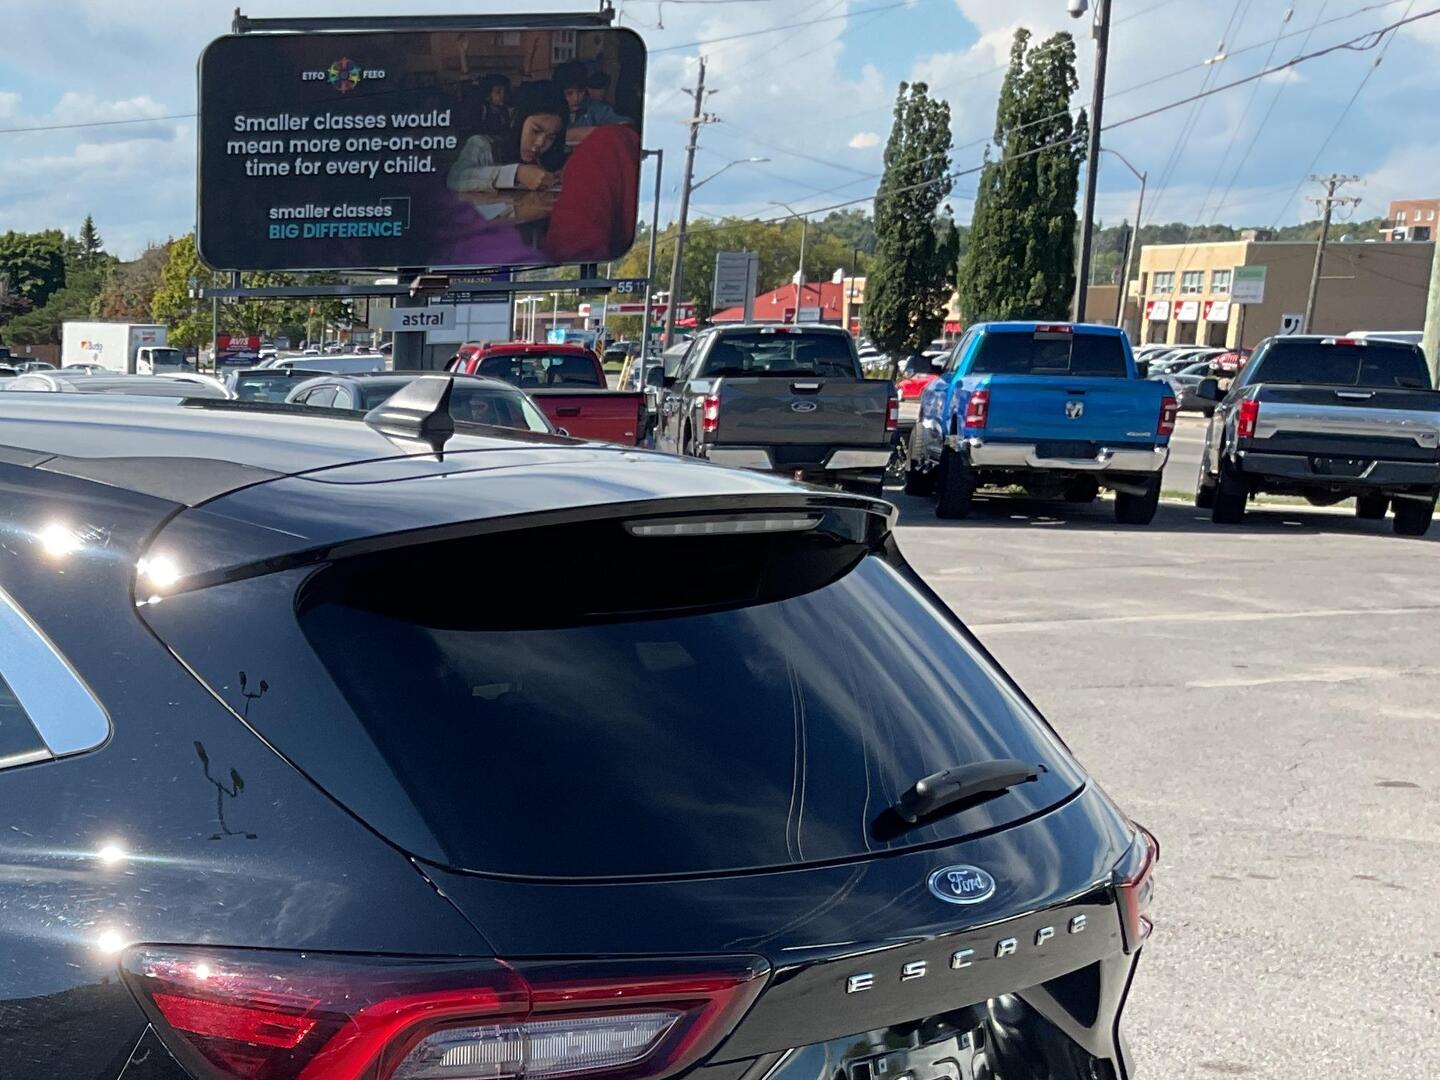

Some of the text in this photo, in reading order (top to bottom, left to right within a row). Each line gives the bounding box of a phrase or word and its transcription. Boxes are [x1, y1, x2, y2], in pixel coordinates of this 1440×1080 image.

[302, 72, 326, 81] ETFO
[234, 109, 452, 132] Smaller classes would
[226, 135, 458, 155] mean more one-on-one
[245, 155, 437, 179] time for every child.
[269, 203, 393, 219] smaller classes
[268, 221, 403, 240] BIG DIFFERENCE
[402, 311, 444, 326] astral
[228, 337, 250, 346] AVIS
[846, 913, 1088, 995] ESCAPE
